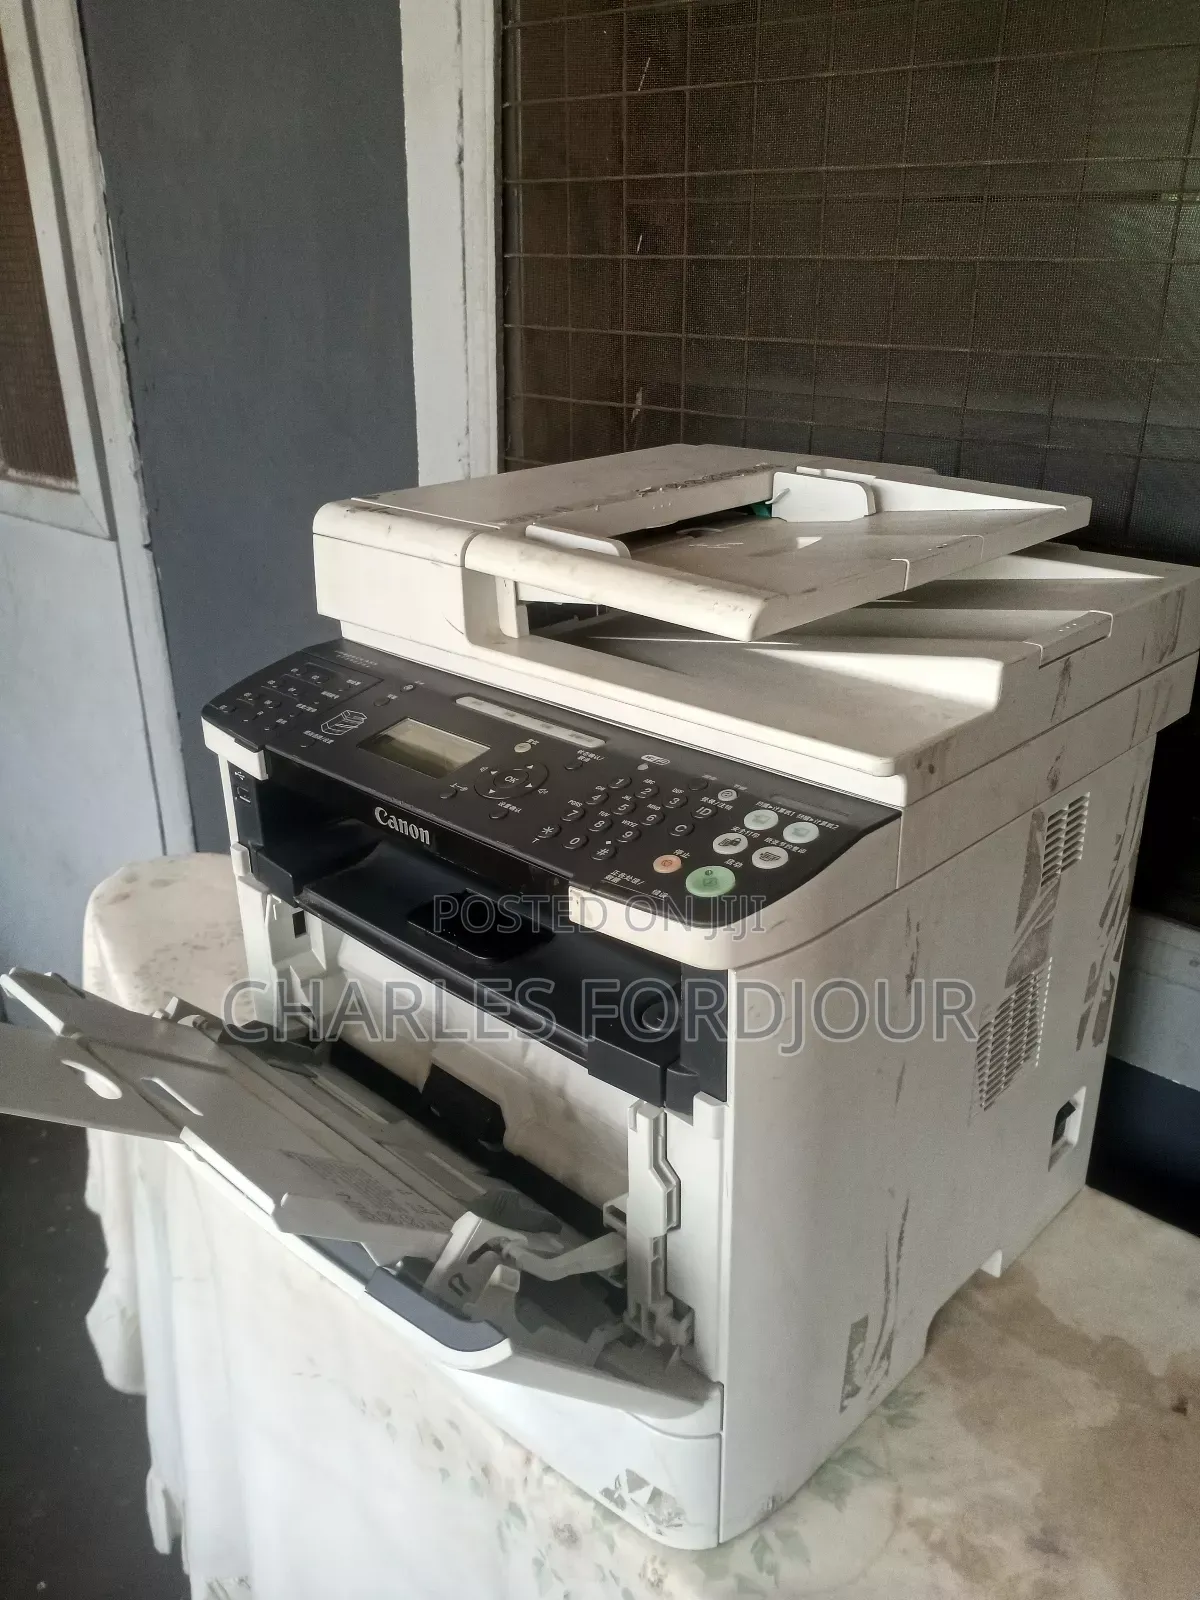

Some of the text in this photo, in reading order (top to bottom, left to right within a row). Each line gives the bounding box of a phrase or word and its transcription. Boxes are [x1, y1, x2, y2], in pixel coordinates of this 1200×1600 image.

[504, 775, 519, 784] OK
[615, 778, 624, 786] 1
[669, 797, 680, 805] 3
[617, 803, 629, 811] 5
[695, 806, 713, 816] ID
[567, 809, 579, 817] 7
[646, 814, 657, 822] 6
[374, 806, 430, 845] Canon
[594, 820, 605, 828] 8
[674, 824, 687, 833] C
[621, 830, 633, 839] 9
[569, 837, 580, 845] 0
[596, 848, 610, 856] #
[673, 848, 691, 859] 停止
